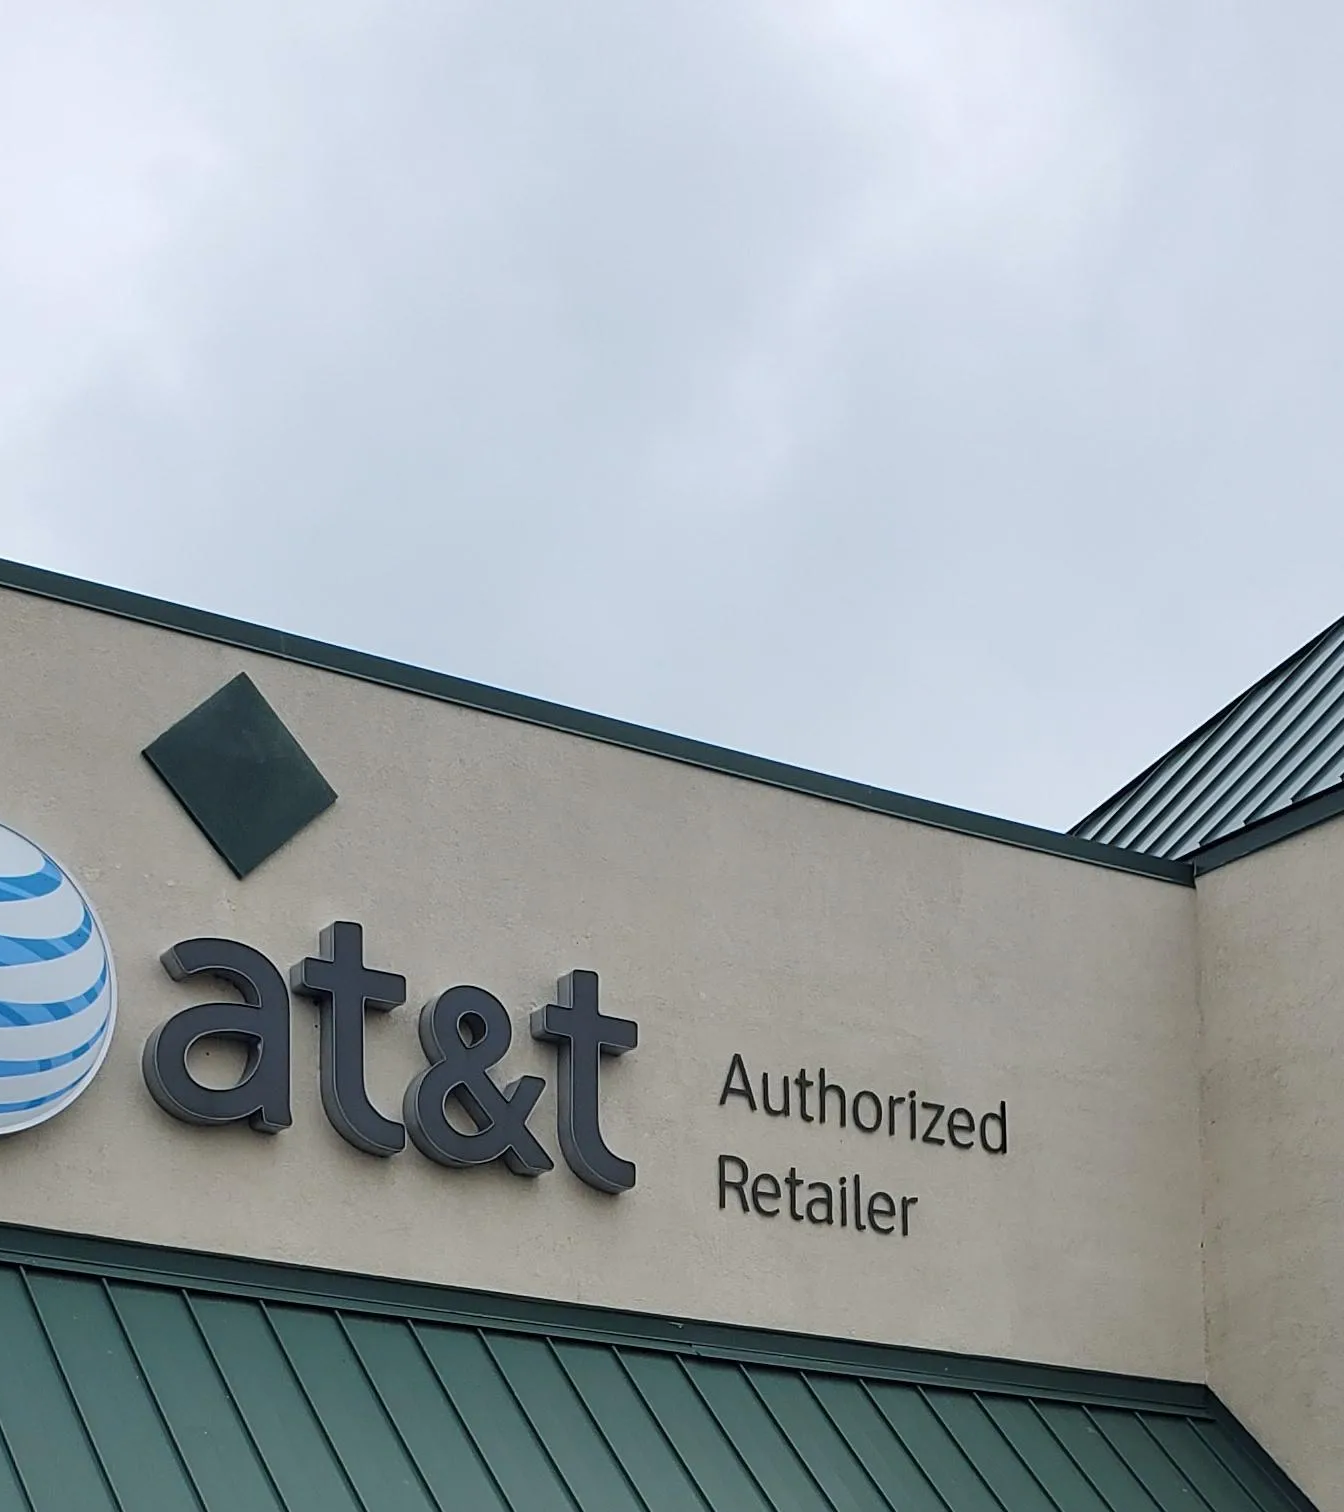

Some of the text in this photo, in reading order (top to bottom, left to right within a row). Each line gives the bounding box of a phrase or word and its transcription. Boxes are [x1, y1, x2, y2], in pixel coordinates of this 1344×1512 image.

[143, 920, 638, 1194] at&t
[718, 1052, 1009, 1156] Authorized
[718, 1154, 919, 1237] Retailer
